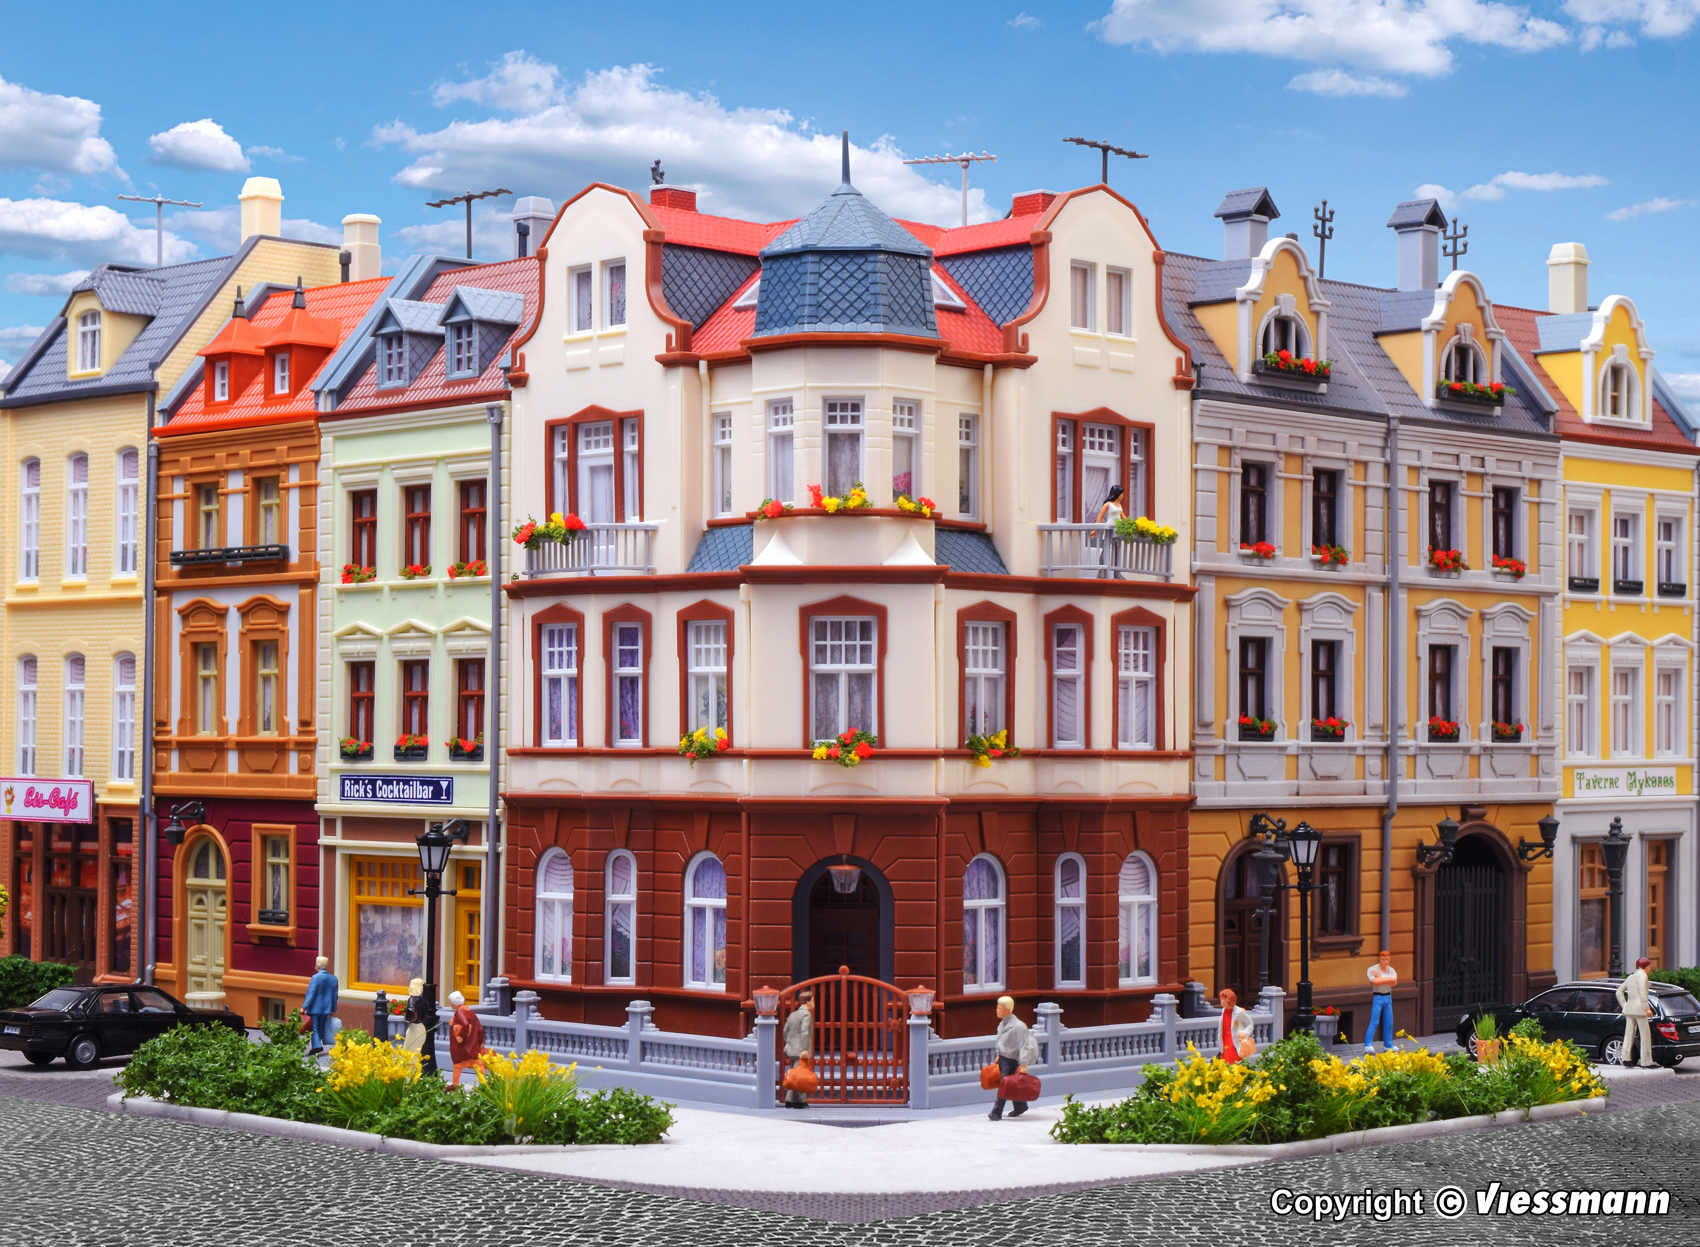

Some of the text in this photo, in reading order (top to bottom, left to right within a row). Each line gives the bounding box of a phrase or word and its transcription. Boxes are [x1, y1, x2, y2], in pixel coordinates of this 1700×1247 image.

[344, 779, 434, 799] Rick's Cocktailbar
[1575, 771, 1675, 796] Taverne Mykonos
[24, 786, 79, 817] Eis-Café
